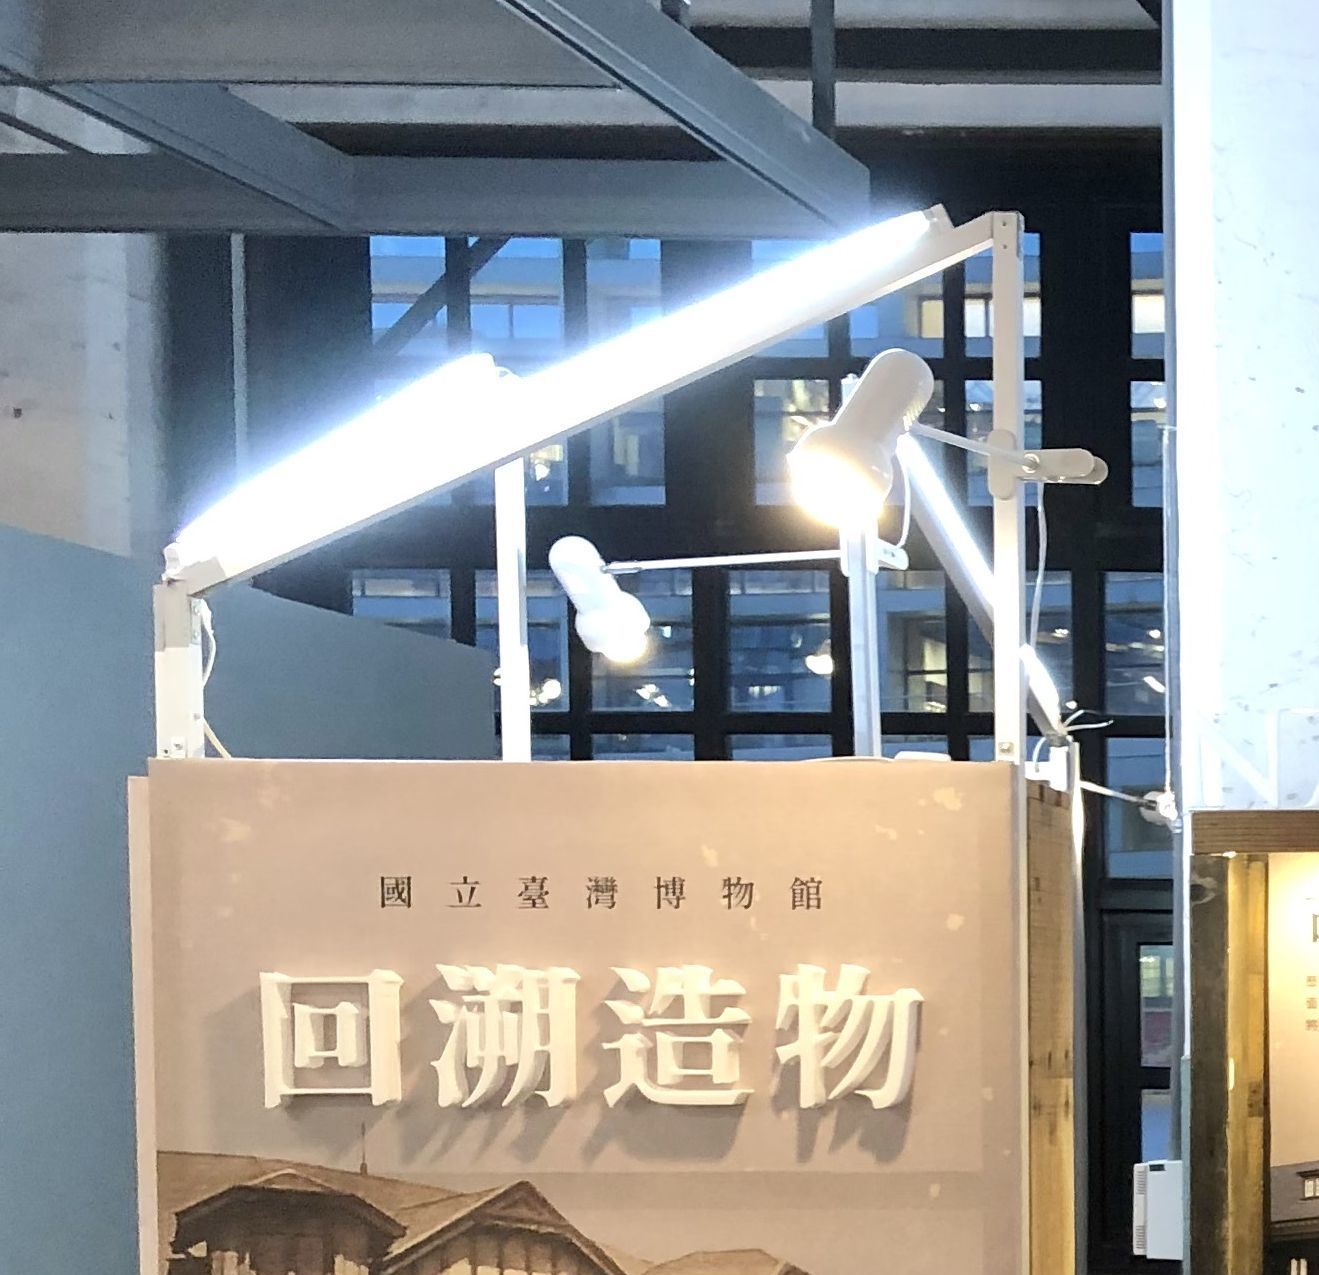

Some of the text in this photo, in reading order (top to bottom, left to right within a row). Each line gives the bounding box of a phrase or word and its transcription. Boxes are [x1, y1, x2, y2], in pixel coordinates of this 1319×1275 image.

[379, 874, 826, 912] 國立臺灣博物館
[258, 961, 926, 1110] 回溯造物
